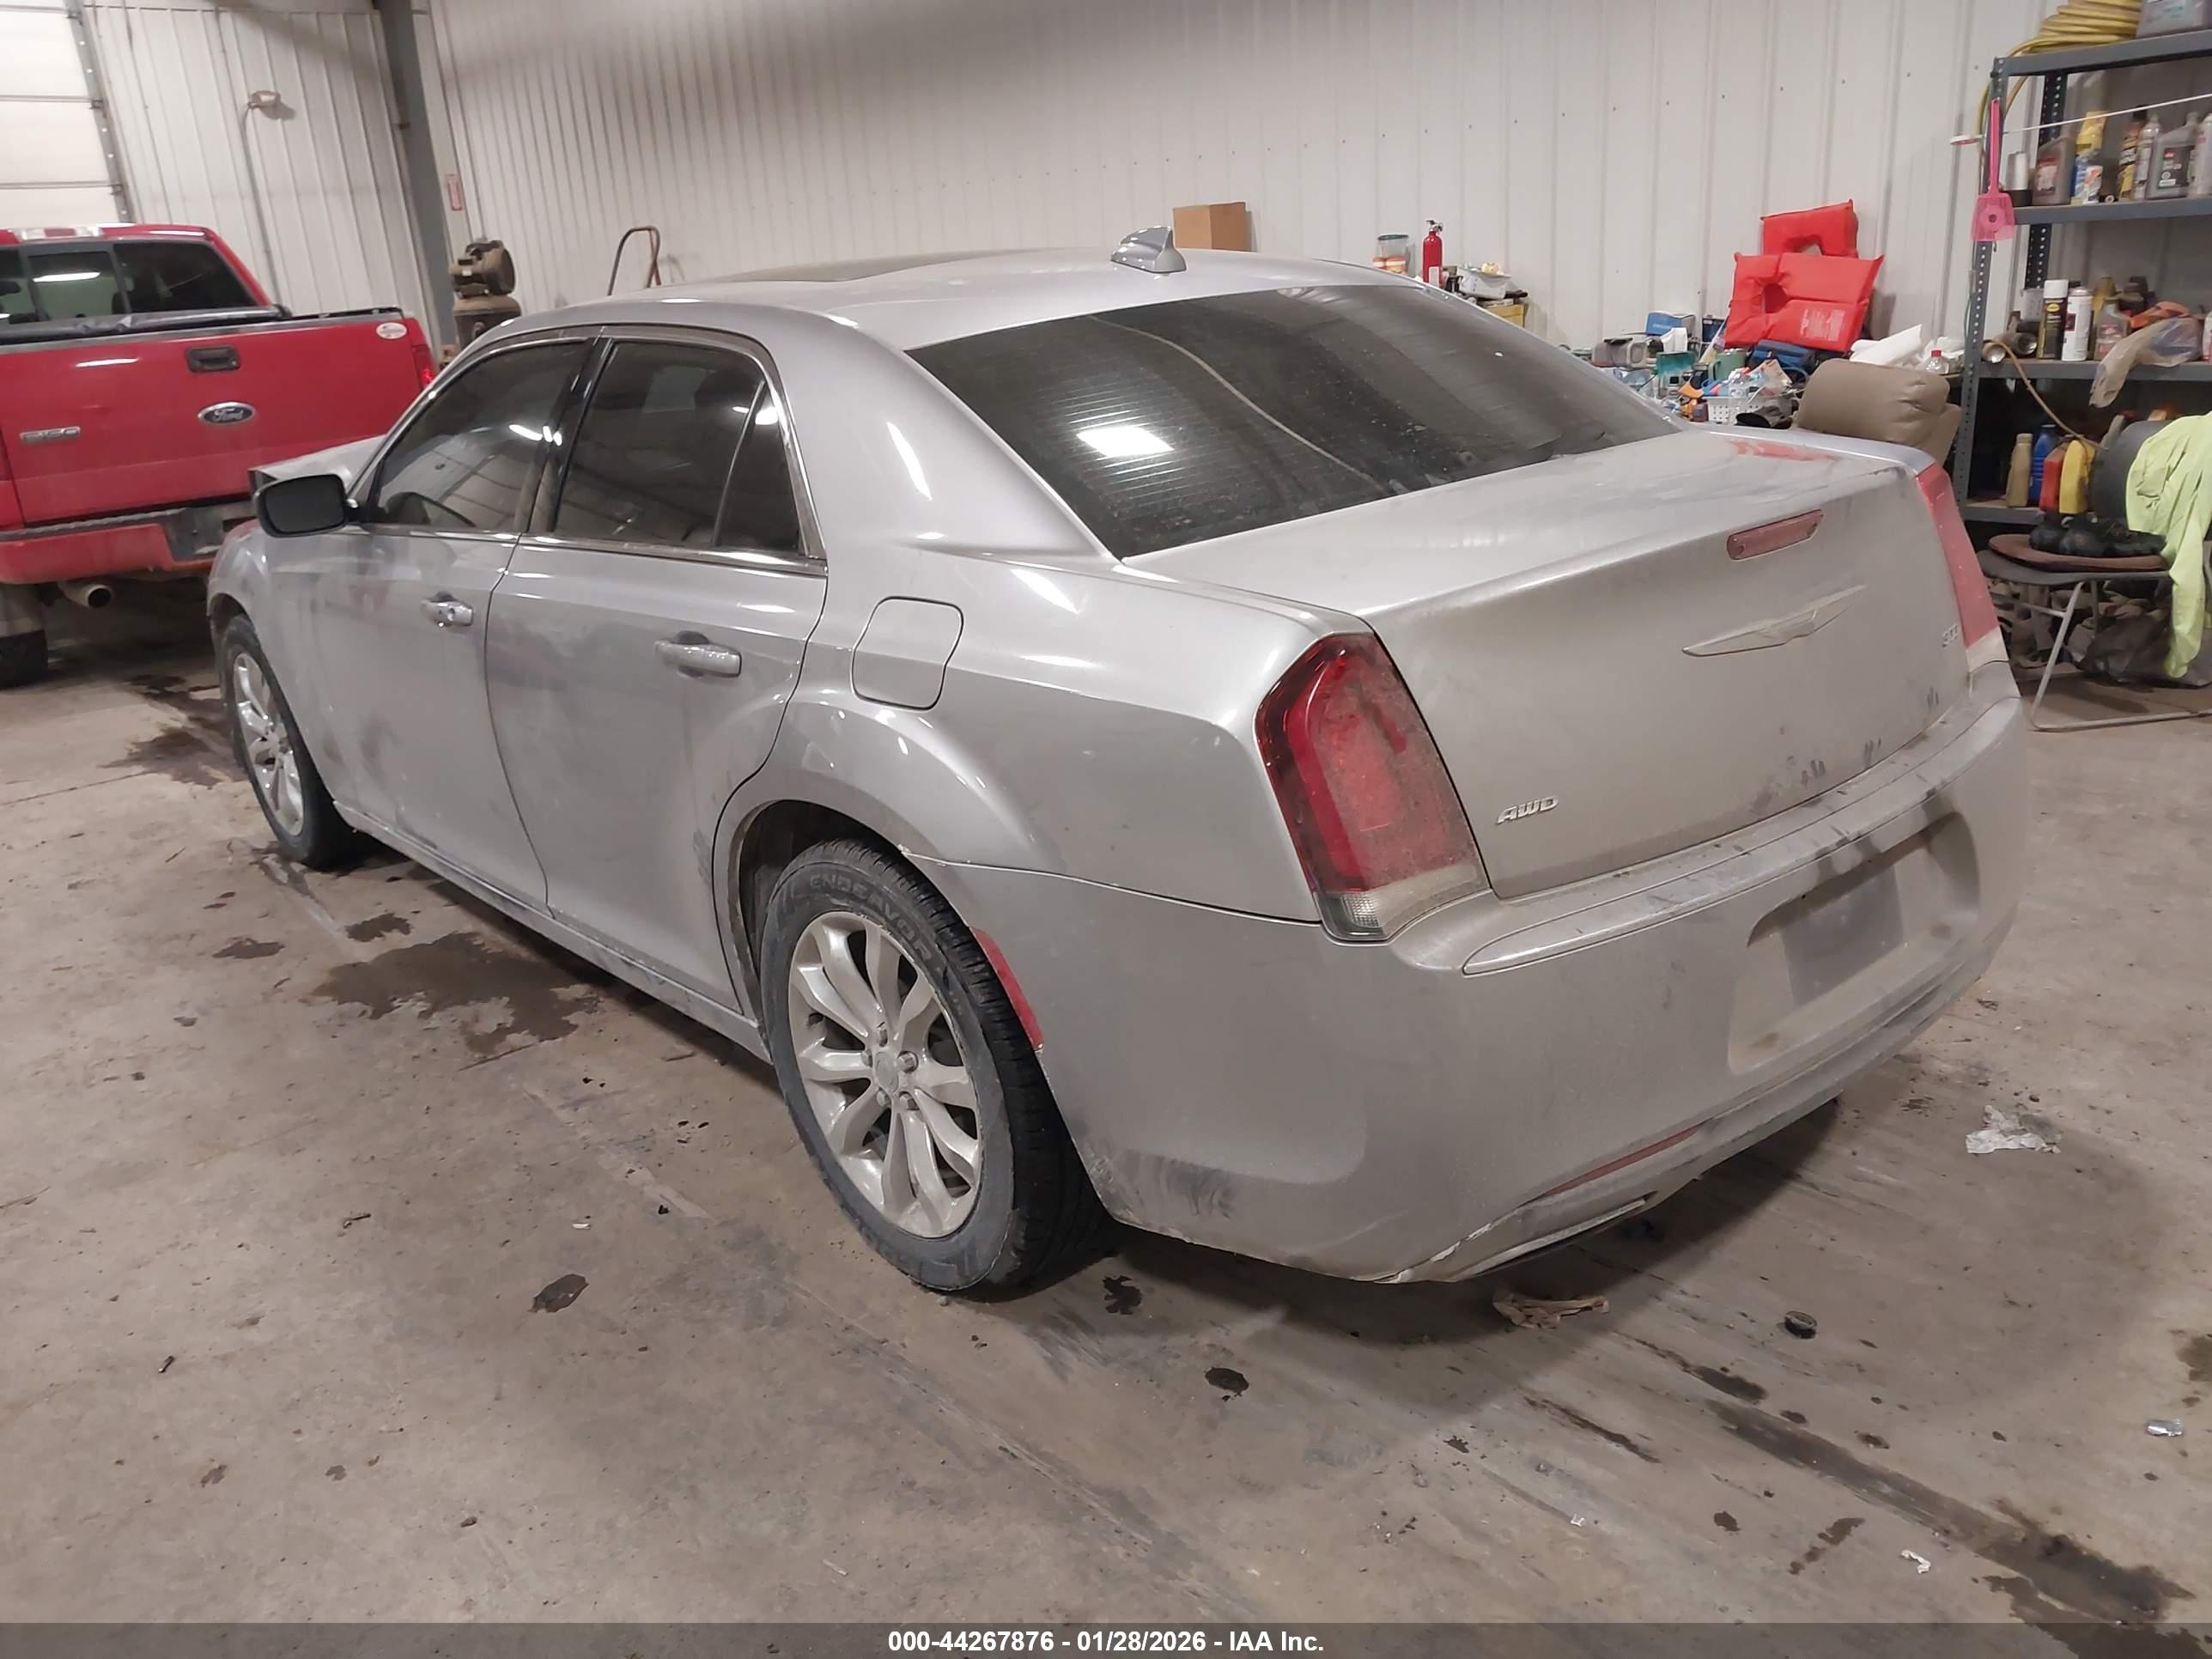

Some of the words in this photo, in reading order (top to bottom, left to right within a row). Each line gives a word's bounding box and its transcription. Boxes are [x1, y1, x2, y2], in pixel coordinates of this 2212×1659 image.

[213, 408, 244, 422] Ford
[1496, 795, 1559, 824] AWD
[810, 872, 933, 961] ENDEAVOR
